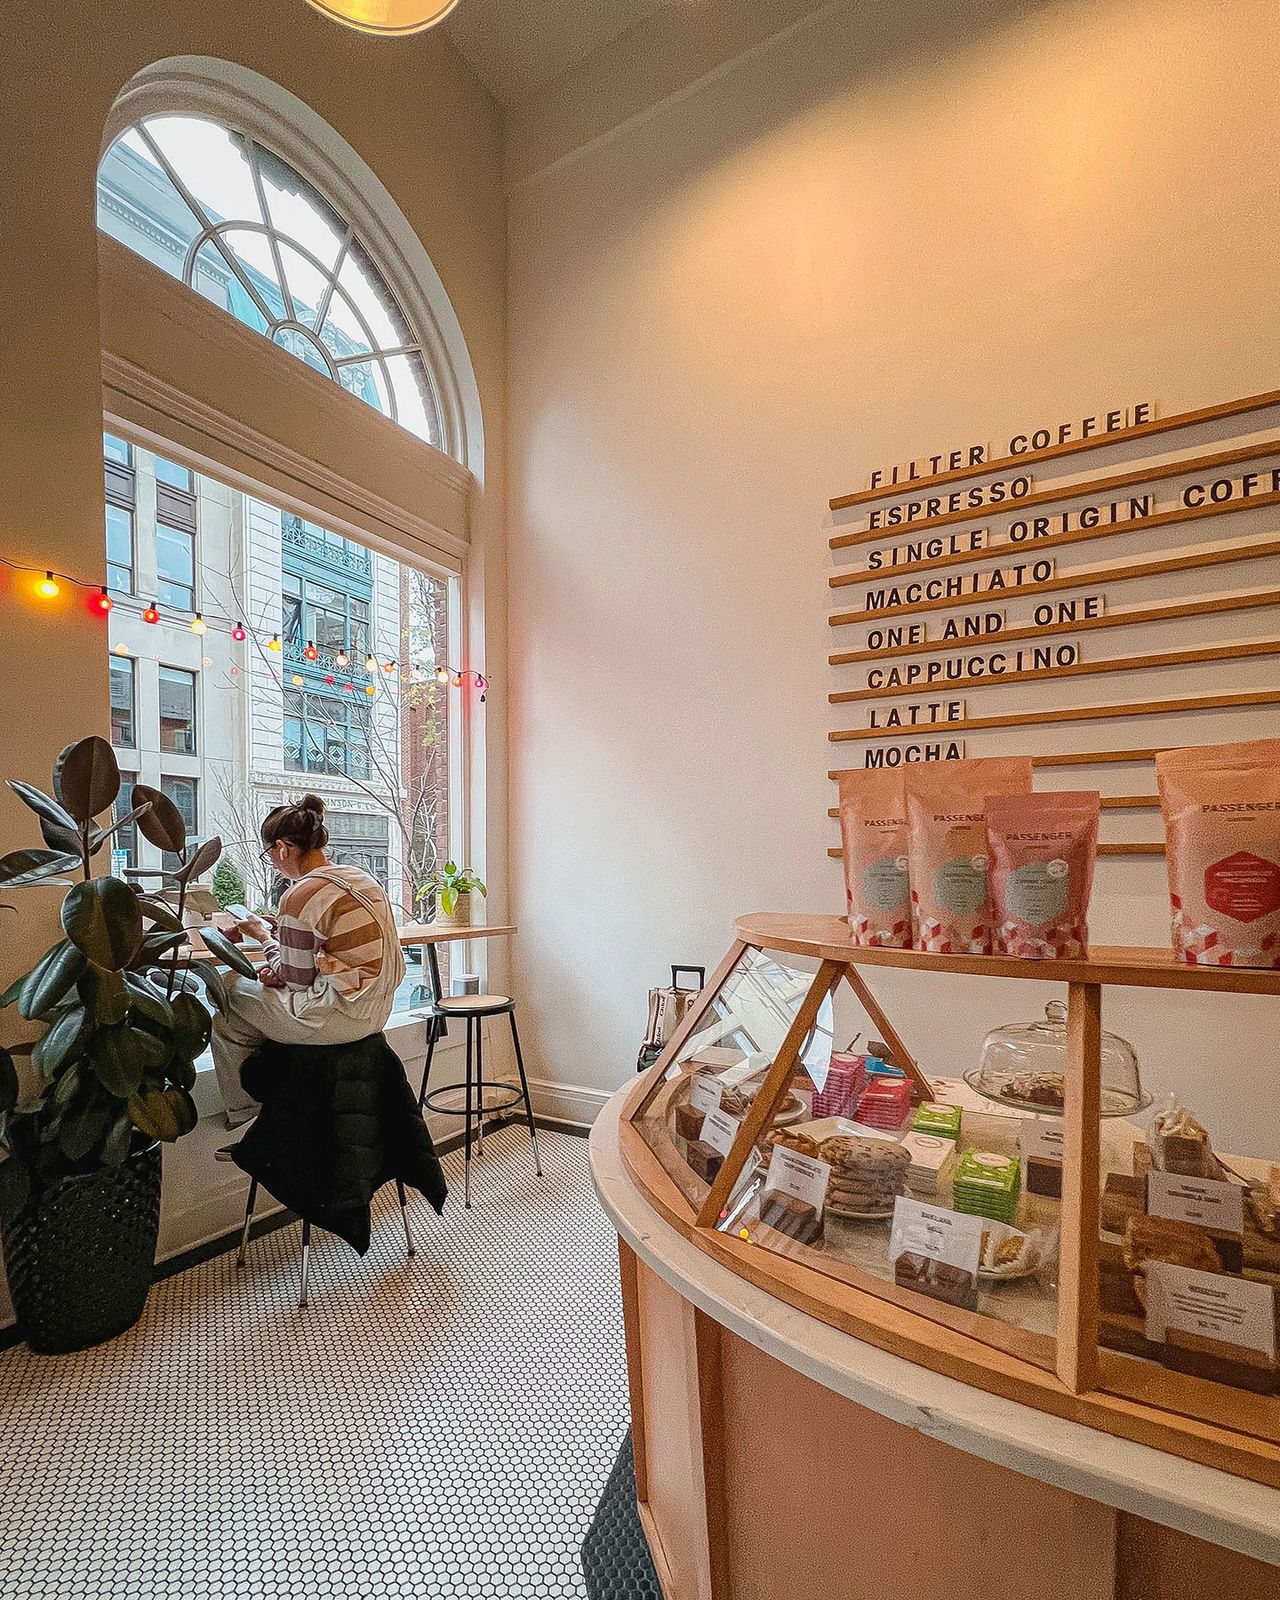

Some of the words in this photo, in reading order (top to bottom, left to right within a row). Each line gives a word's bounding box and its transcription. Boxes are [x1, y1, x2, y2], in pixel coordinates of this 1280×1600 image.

[870, 445, 984, 490] FILTER
[1009, 403, 1149, 456] COFFEE
[869, 477, 1029, 531] ESPRESSO
[868, 529, 983, 570] SINGLE
[1009, 495, 1149, 542] ORIGIN
[866, 560, 1052, 611] MACCHIATO
[867, 624, 921, 650] ONE
[942, 613, 1003, 641] AND
[1034, 596, 1099, 626] ONE
[867, 644, 1076, 690] CAPPUCCINO
[870, 701, 960, 729] LATTE
[865, 742, 960, 769] MOCHA
[1006, 831, 1072, 841] PASSENGER
